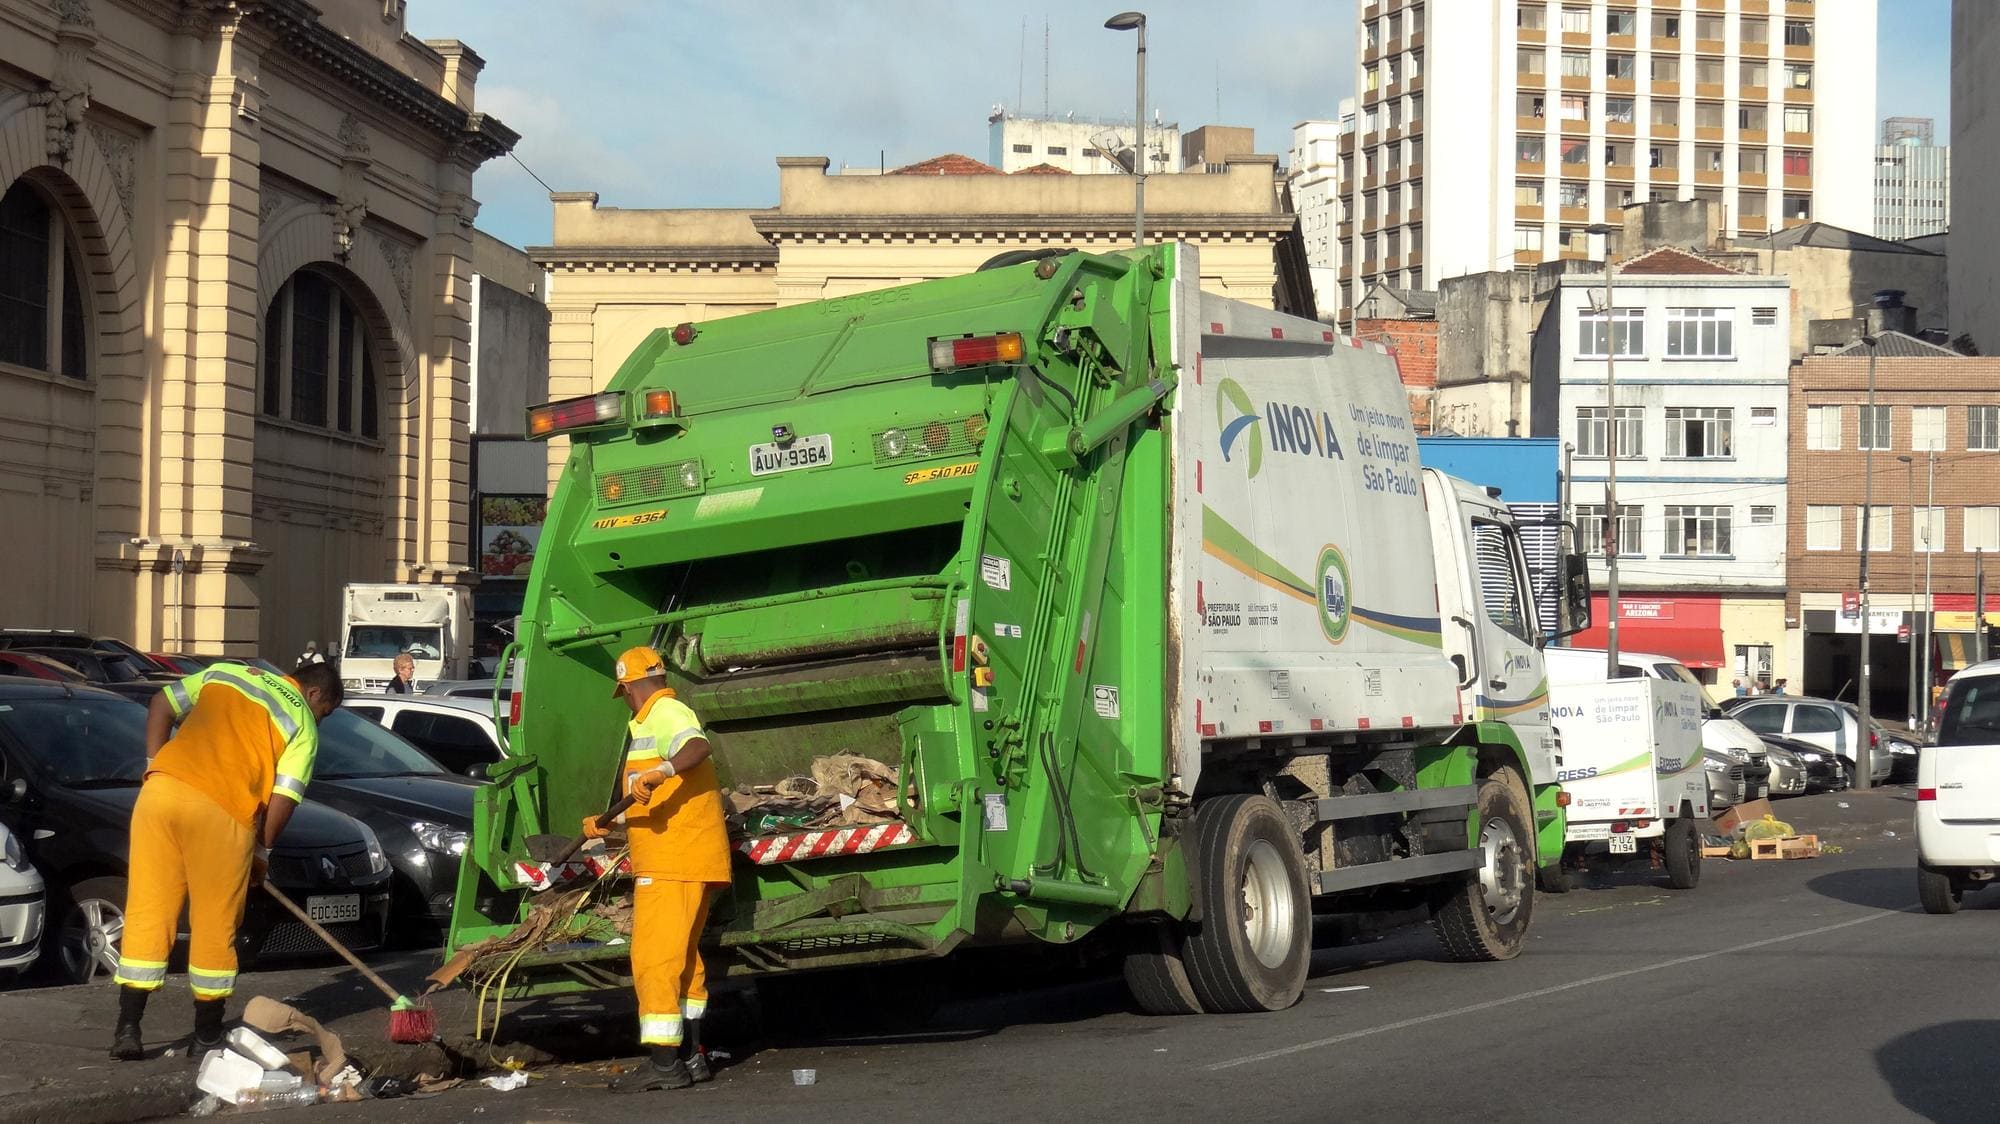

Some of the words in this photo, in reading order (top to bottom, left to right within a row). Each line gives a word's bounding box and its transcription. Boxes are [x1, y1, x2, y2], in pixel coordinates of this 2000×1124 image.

[1349, 402, 1364, 422] Um
[1366, 407, 1386, 429] jeito
[1387, 414, 1406, 430] novo
[1266, 401, 1345, 461] INOVA
[1357, 431, 1373, 457] de
[1373, 433, 1410, 467] limpar
[904, 472, 919, 484] SP
[1362, 464, 1385, 492] São
[1386, 468, 1418, 497] Paulo
[593, 518, 619, 529] AUV
[631, 510, 669, 525] 9364
[1207, 603, 1234, 613] PREFEITURA
[1234, 603, 1241, 612] DE
[1625, 609, 1658, 617] ARIZONA
[1207, 612, 1221, 627] SÃO
[1221, 614, 1241, 627] PAULO
[1514, 654, 1531, 669] INOVA
[276, 686, 302, 708] PAULO
[1551, 706, 1585, 718] NOVA
[1595, 705, 1608, 714] de
[1609, 703, 1640, 715] limpar
[1663, 701, 1679, 717] INOVA
[1596, 714, 1614, 723] São
[1615, 713, 1641, 722] Paulo
[1659, 756, 1681, 771] EXPRESS
[1557, 766, 1598, 781] RESS
[1612, 843, 1634, 852] 7194
